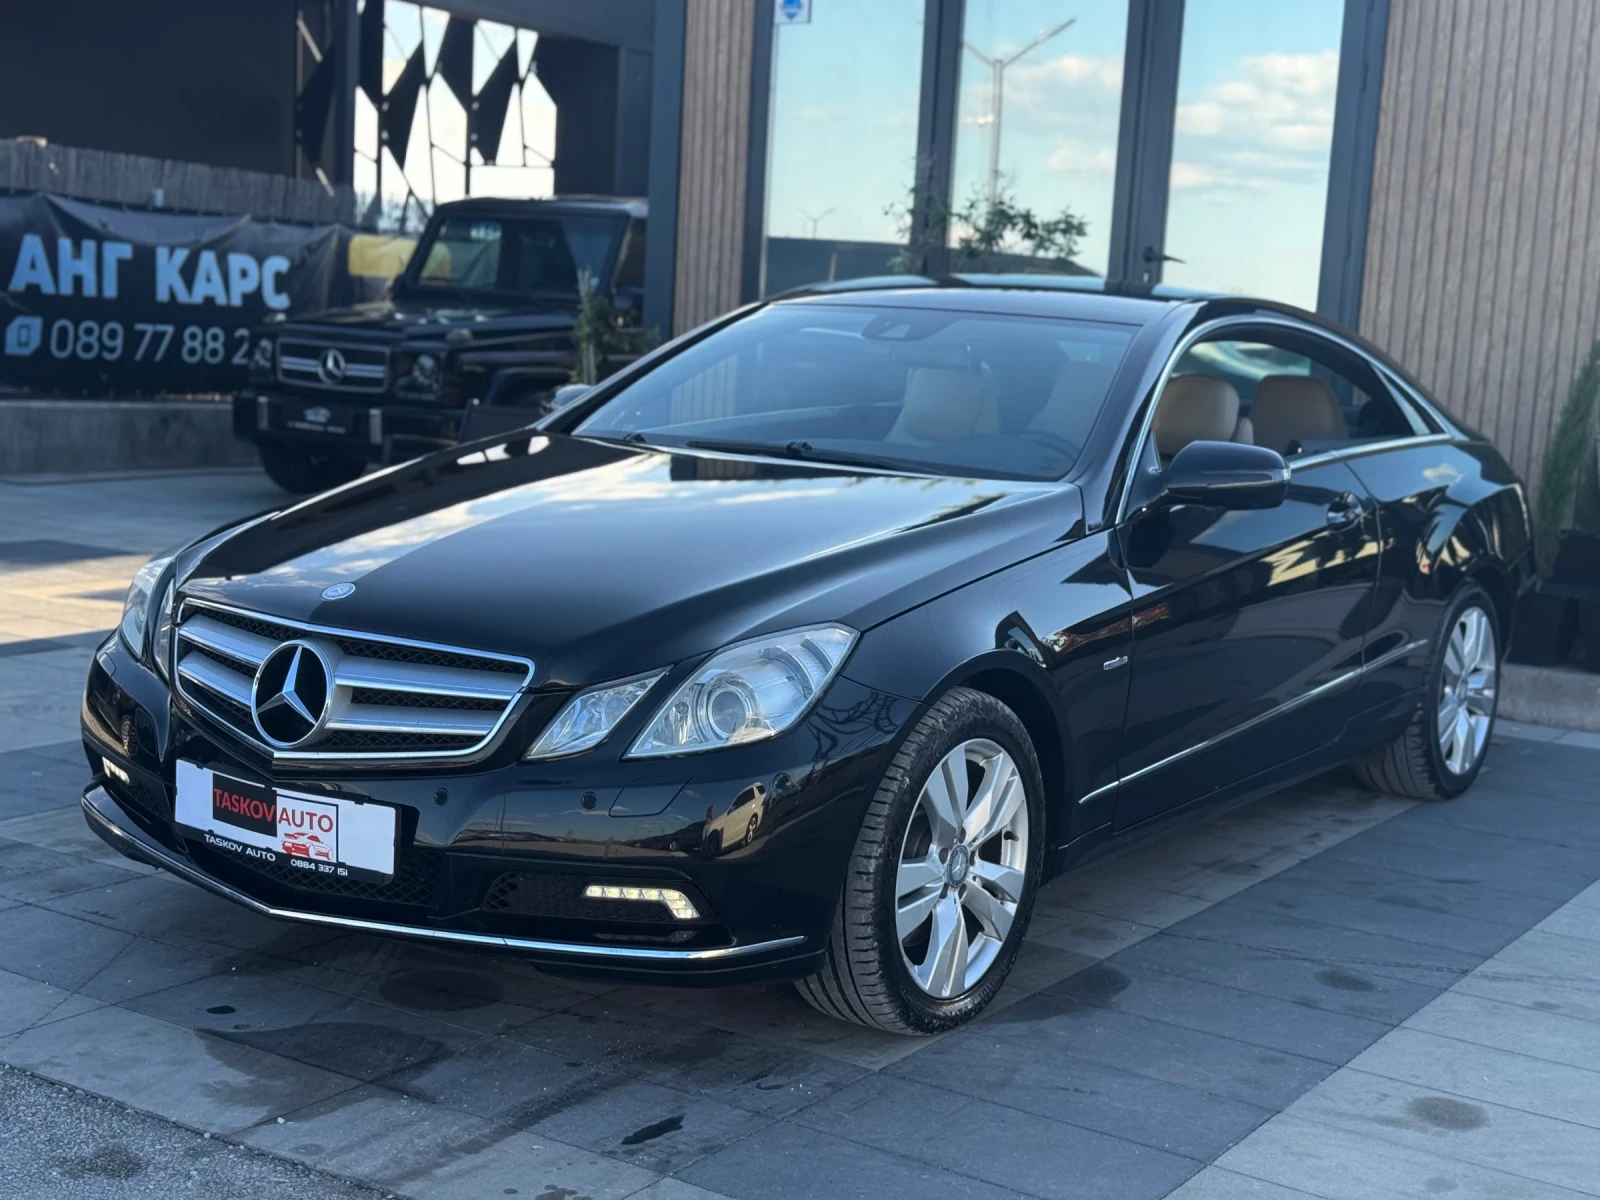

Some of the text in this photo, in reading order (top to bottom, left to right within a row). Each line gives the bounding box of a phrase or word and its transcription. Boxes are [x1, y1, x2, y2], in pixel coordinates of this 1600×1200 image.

[8, 233, 291, 310] АНГ КАРС
[51, 319, 249, 364] 089 77 88 2
[214, 788, 334, 833] TASKOV AUTO
[204, 834, 242, 852] TASKOV
[246, 848, 275, 861] AUTO
[290, 859, 315, 870] 0884
[318, 864, 334, 873] 337
